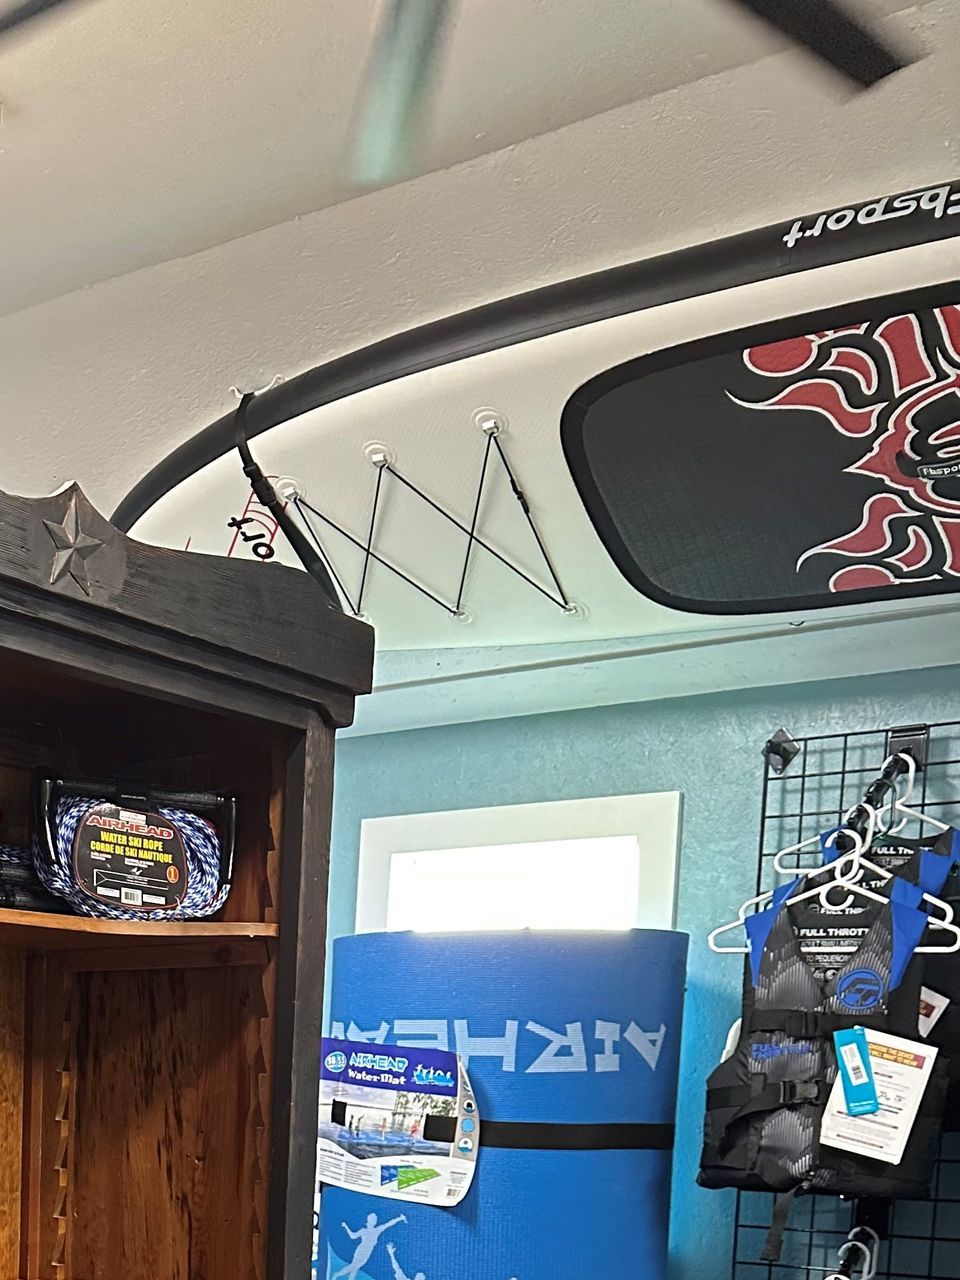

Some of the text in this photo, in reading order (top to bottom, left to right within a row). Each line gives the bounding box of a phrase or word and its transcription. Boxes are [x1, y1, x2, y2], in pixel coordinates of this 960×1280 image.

[86, 815, 174, 839] AIRHEAD
[90, 841, 114, 853] CORDE
[115, 845, 124, 856] DE
[125, 847, 137, 858] SKI
[138, 849, 172, 863] NAUTIQUE
[101, 831, 163, 851] WATER SKI ROPE
[800, 928, 827, 937] FULL
[330, 1019, 667, 1074] AIRHEA
[349, 1051, 409, 1073] AIRHEAD
